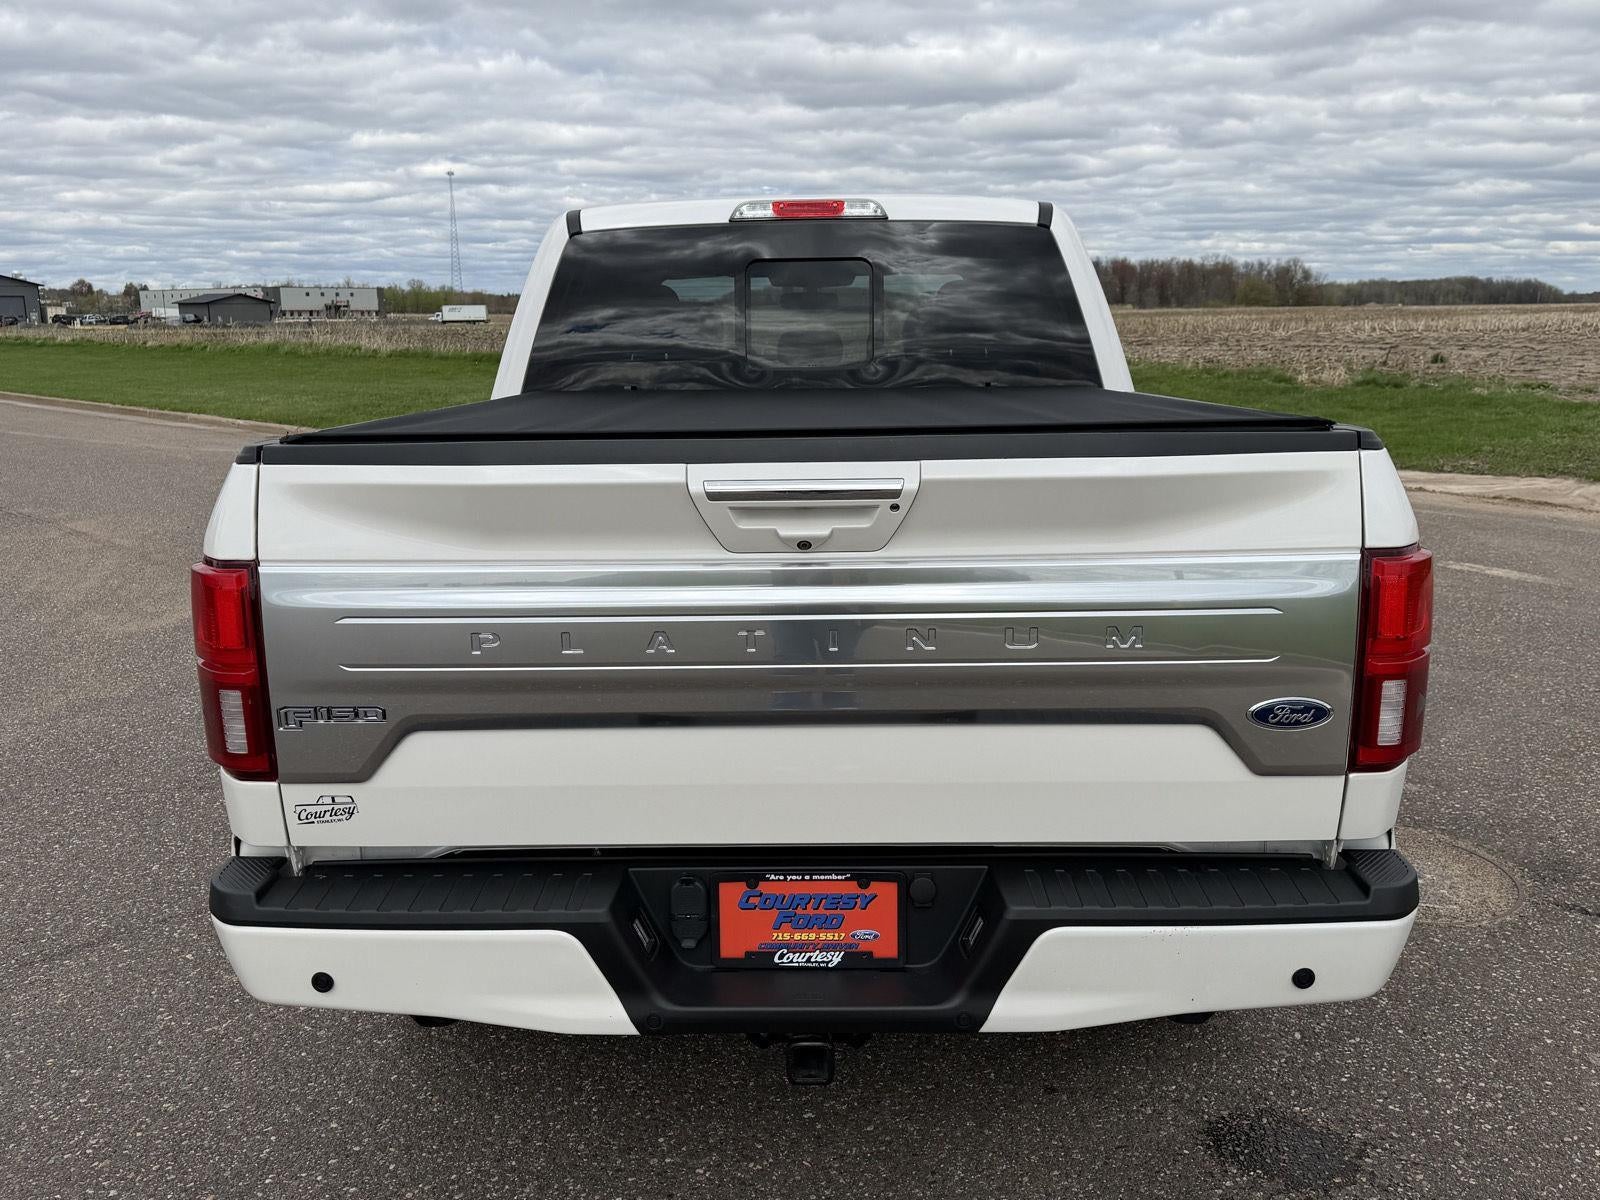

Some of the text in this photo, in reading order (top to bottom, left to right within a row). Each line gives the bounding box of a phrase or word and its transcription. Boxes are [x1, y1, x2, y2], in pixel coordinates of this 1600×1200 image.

[470, 624, 1144, 655] PLATINUM
[1268, 704, 1316, 724] Ford
[297, 805, 357, 821] Courtesy
[786, 874, 802, 882] you
[771, 932, 846, 941] 715-669-5517
[773, 949, 845, 967] Courtesy
